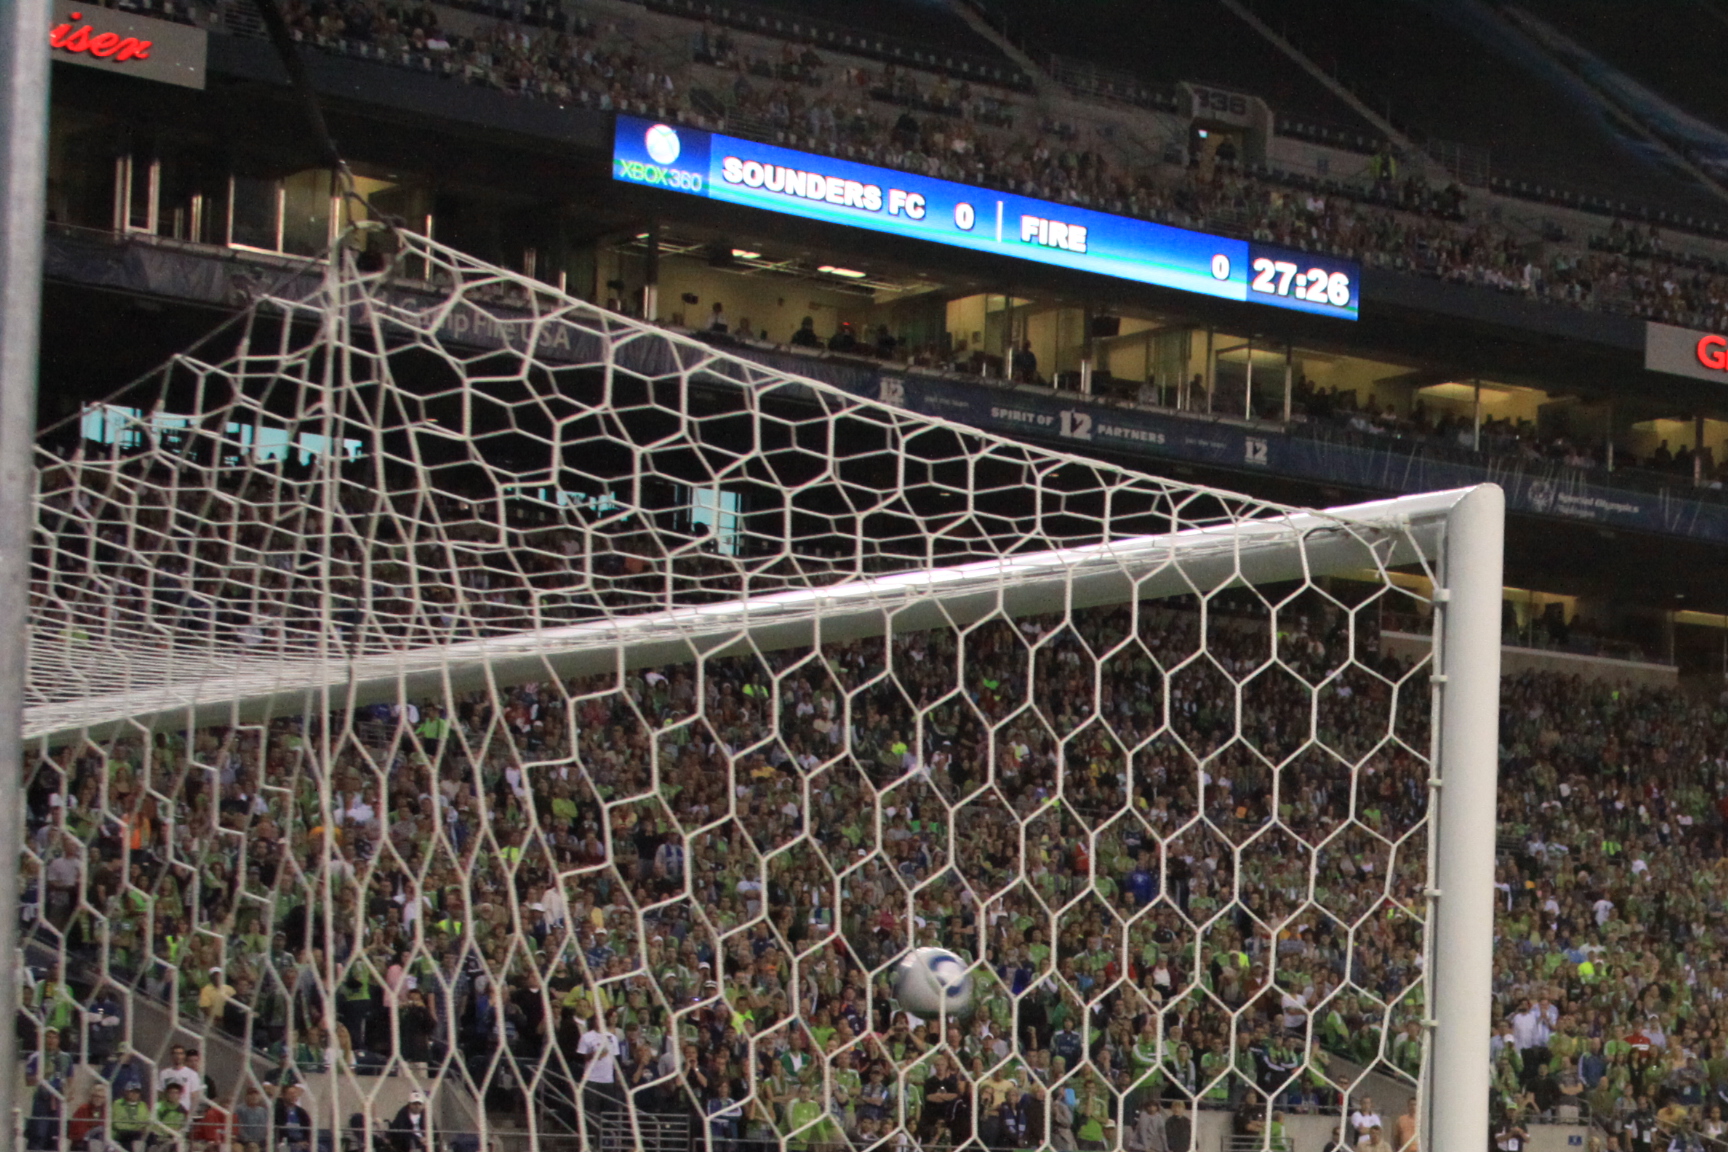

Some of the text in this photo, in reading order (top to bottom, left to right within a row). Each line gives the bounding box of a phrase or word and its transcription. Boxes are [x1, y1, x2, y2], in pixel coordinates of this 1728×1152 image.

[620, 160, 703, 191] XBOX 360
[723, 156, 976, 230] SOUNDERS FC 0
[1020, 214, 1349, 307] FIRE 0 27:26
[992, 407, 1035, 423] SPIRIT
[1037, 415, 1054, 426] OF
[1054, 409, 1087, 441] 12
[1098, 424, 1166, 445] PARTNERS
[1244, 436, 1268, 465] 12
